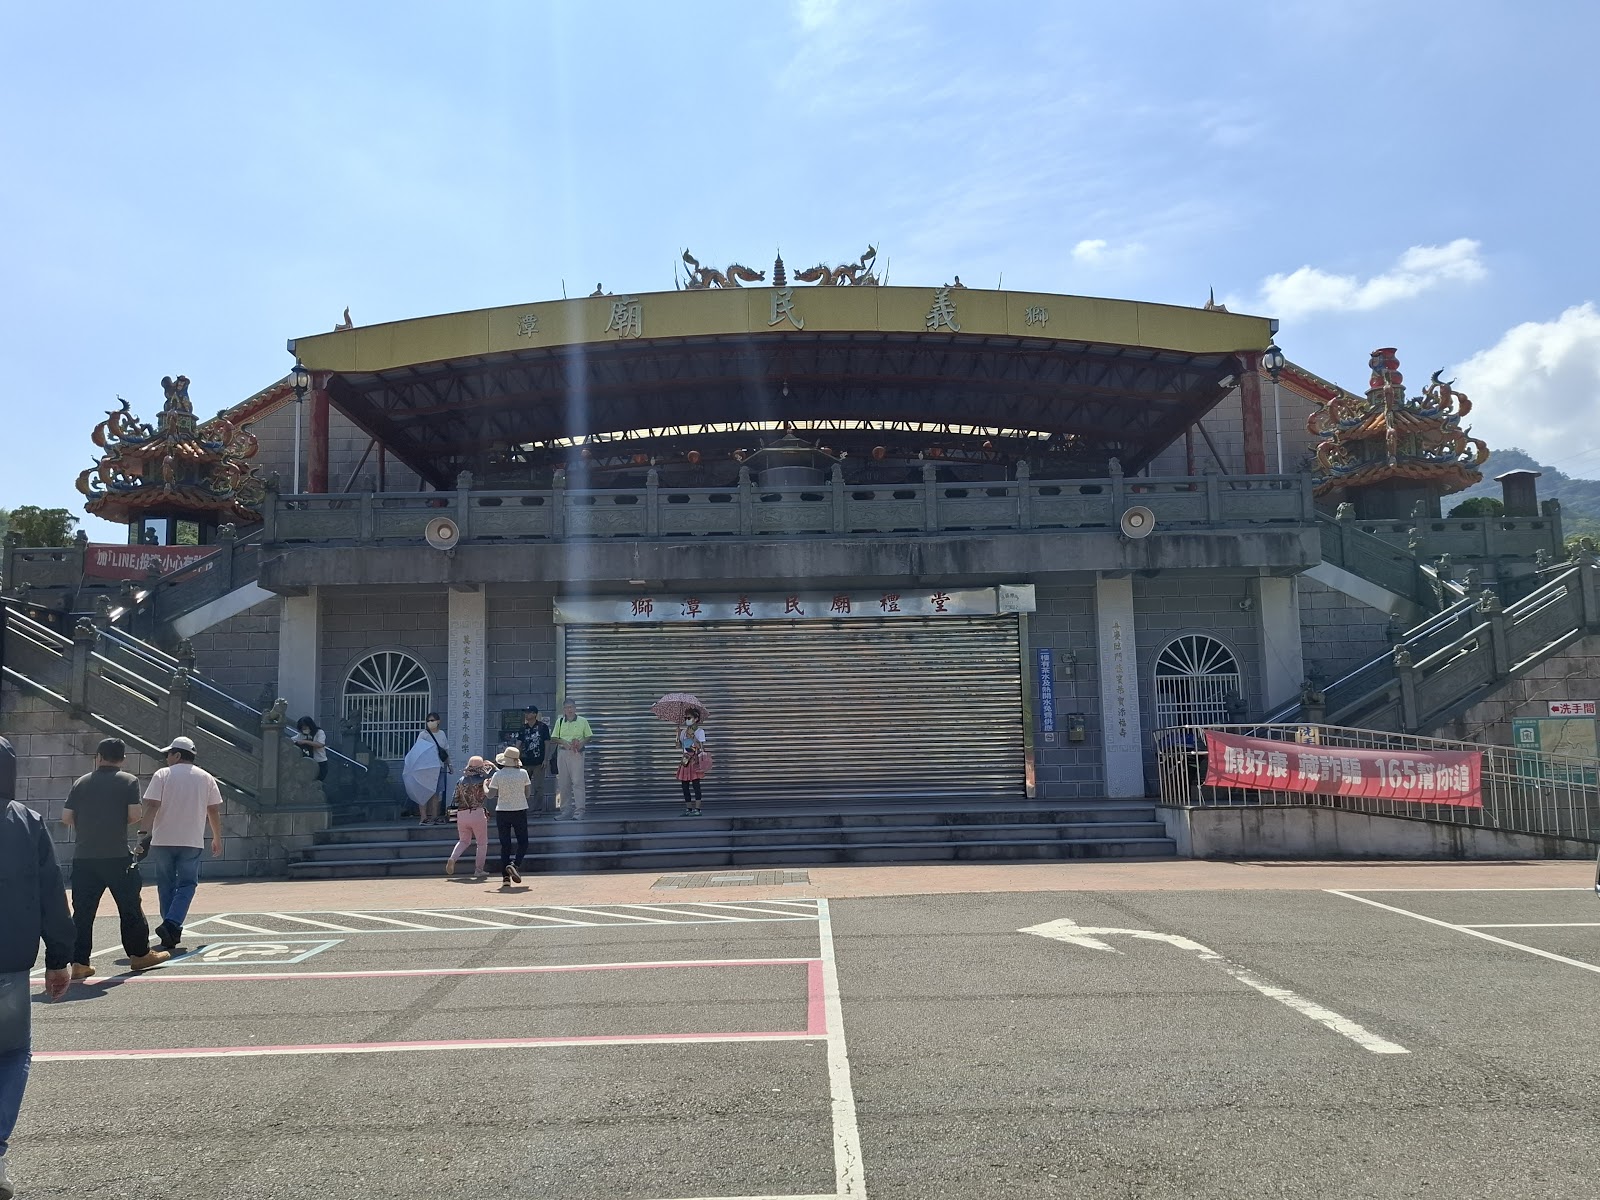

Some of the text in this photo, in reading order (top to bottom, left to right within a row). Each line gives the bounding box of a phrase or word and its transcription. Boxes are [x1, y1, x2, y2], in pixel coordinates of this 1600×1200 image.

[631, 591, 951, 618] 獅潭義民廟禮堂
[1560, 703, 1595, 714] 洗手間
[1224, 746, 1470, 792] 假好康 藏詐騙 165幫你追
